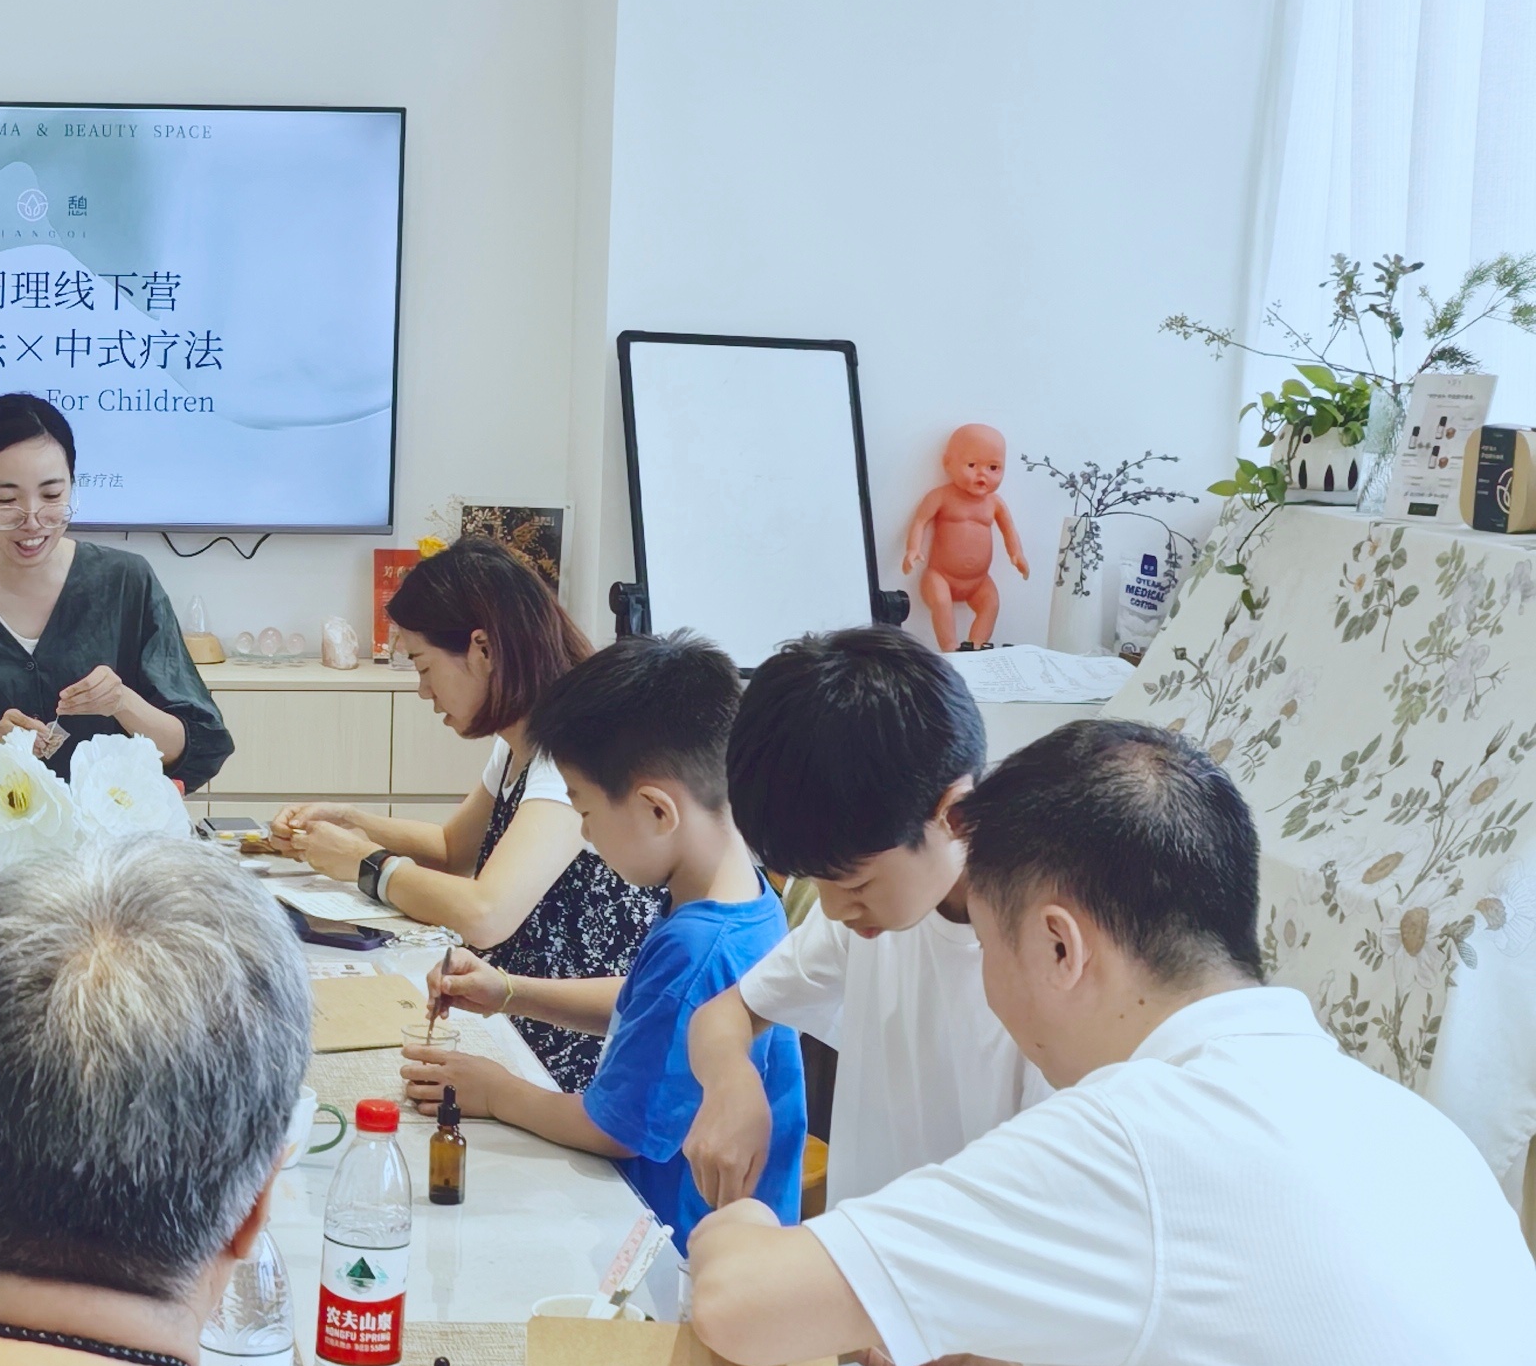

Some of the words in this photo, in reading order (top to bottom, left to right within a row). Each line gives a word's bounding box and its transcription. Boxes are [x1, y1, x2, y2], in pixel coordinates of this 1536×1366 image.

[36, 123, 49, 137] &
[64, 123, 138, 138] BEAUTY
[153, 124, 213, 139] SPACE
[68, 195, 88, 217] 憩
[45, 389, 89, 411] For
[98, 387, 215, 413] Children
[1125, 584, 1165, 603] MEDICAL
[326, 1306, 394, 1331] 农夫山泉
